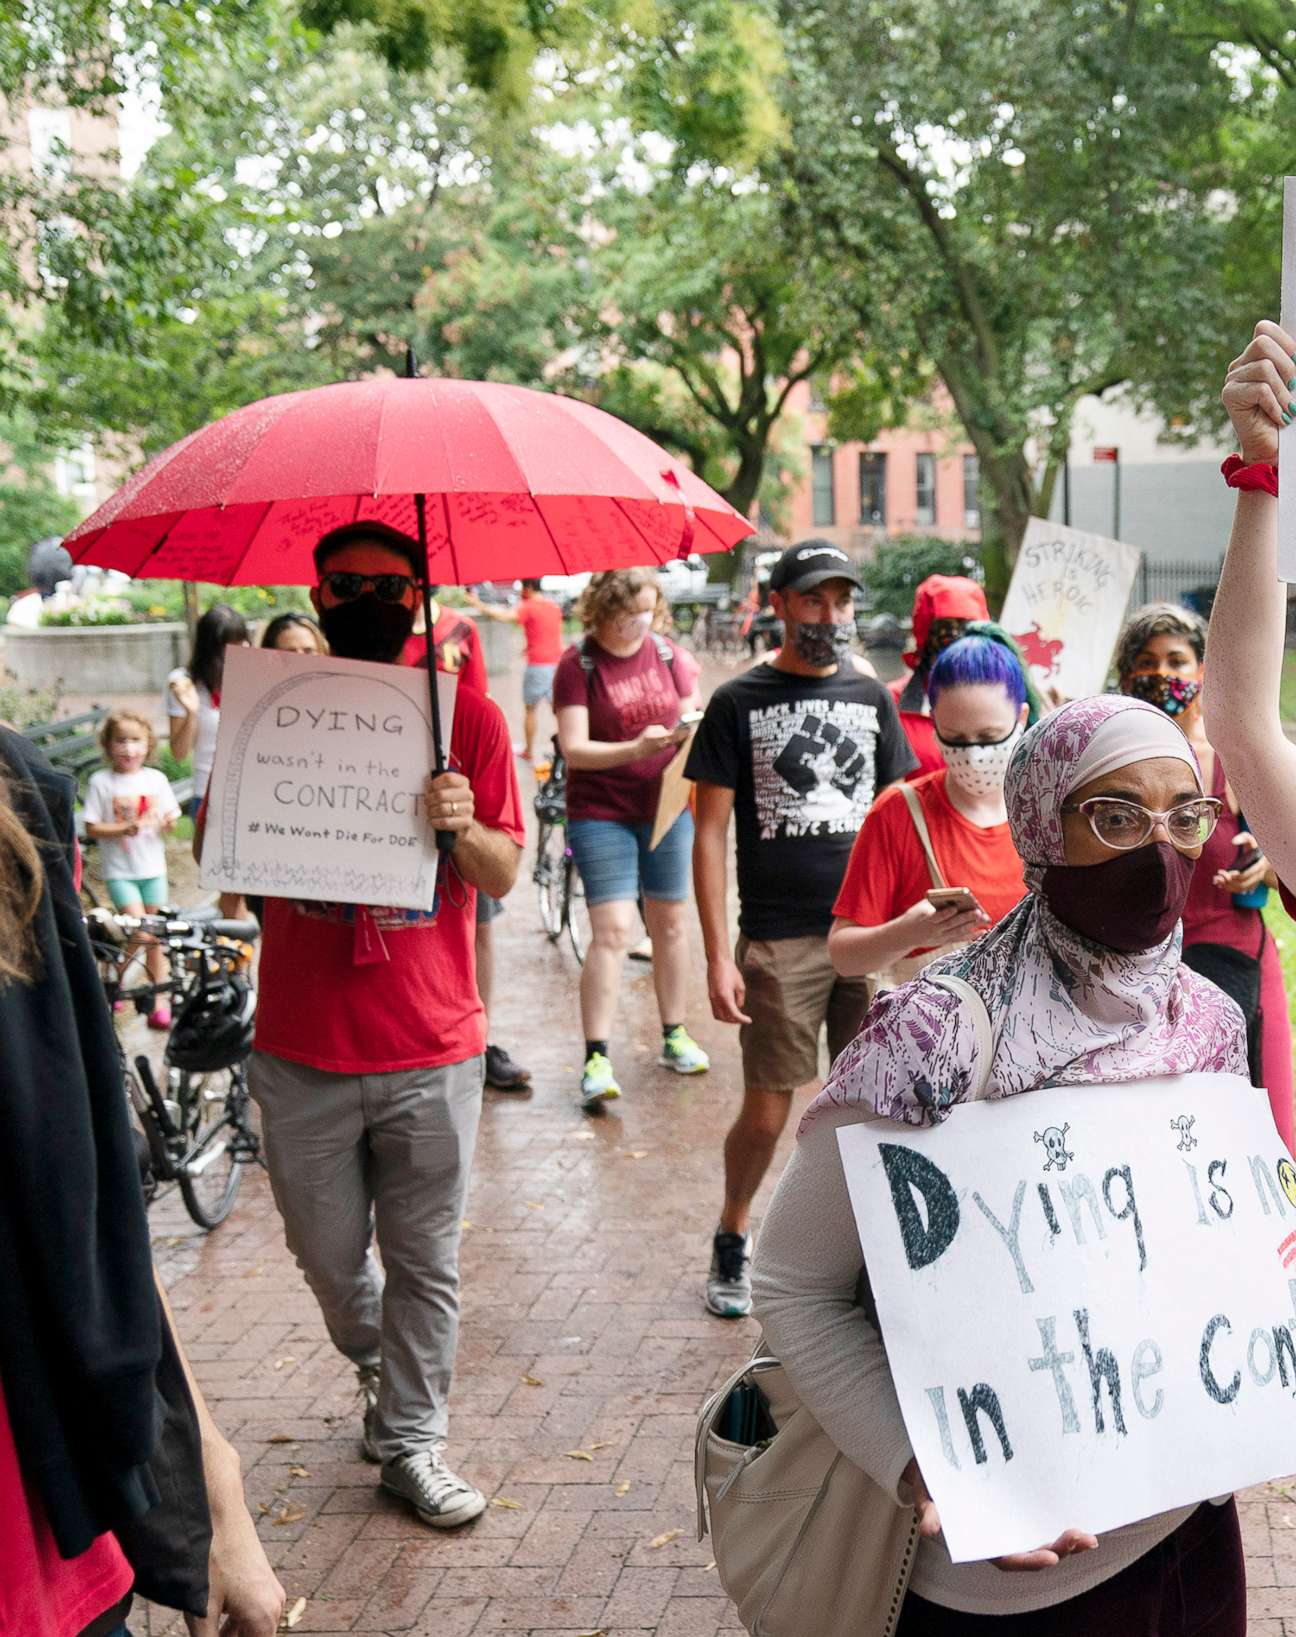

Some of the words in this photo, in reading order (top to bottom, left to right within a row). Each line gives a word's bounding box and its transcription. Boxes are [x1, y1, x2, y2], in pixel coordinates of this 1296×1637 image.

[1025, 540, 1113, 590] STRIKING
[276, 705, 404, 736] DYING
[749, 702, 791, 723] BLACK
[795, 699, 830, 715] LIVES
[832, 700, 878, 719] MATTER
[256, 750, 324, 770] wasn't
[338, 759, 356, 774] in
[364, 760, 401, 778] the
[273, 780, 426, 817] CONTRACT
[336, 829, 358, 842] Die
[362, 832, 384, 845] For
[877, 1141, 1148, 1294] Dying
[1180, 1152, 1235, 1226] is
[1027, 1307, 1166, 1437] the
